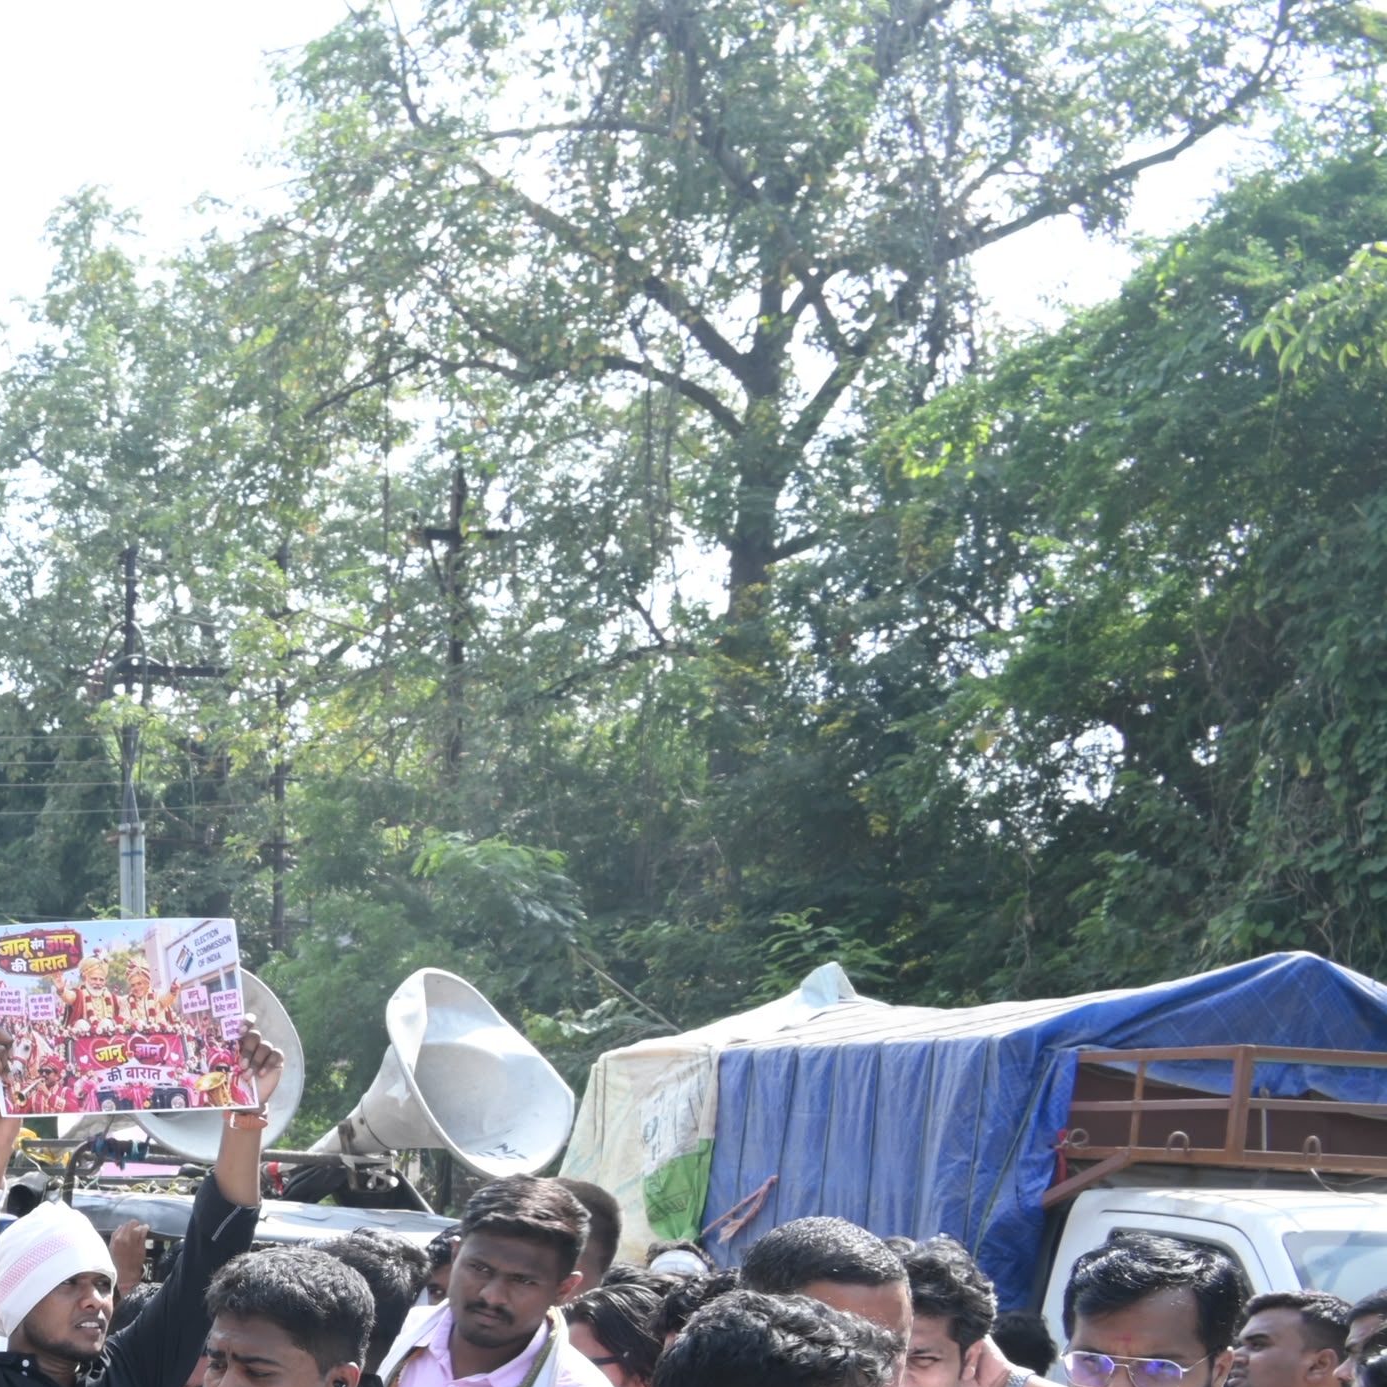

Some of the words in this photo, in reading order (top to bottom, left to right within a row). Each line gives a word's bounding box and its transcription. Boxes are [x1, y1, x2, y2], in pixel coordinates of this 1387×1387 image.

[194, 928, 219, 946] ELECTION
[196, 935, 232, 957] COMMISSION
[94, 1044, 127, 1064] जानू
[107, 1066, 123, 1083] की
[127, 1065, 162, 1081] बारात
